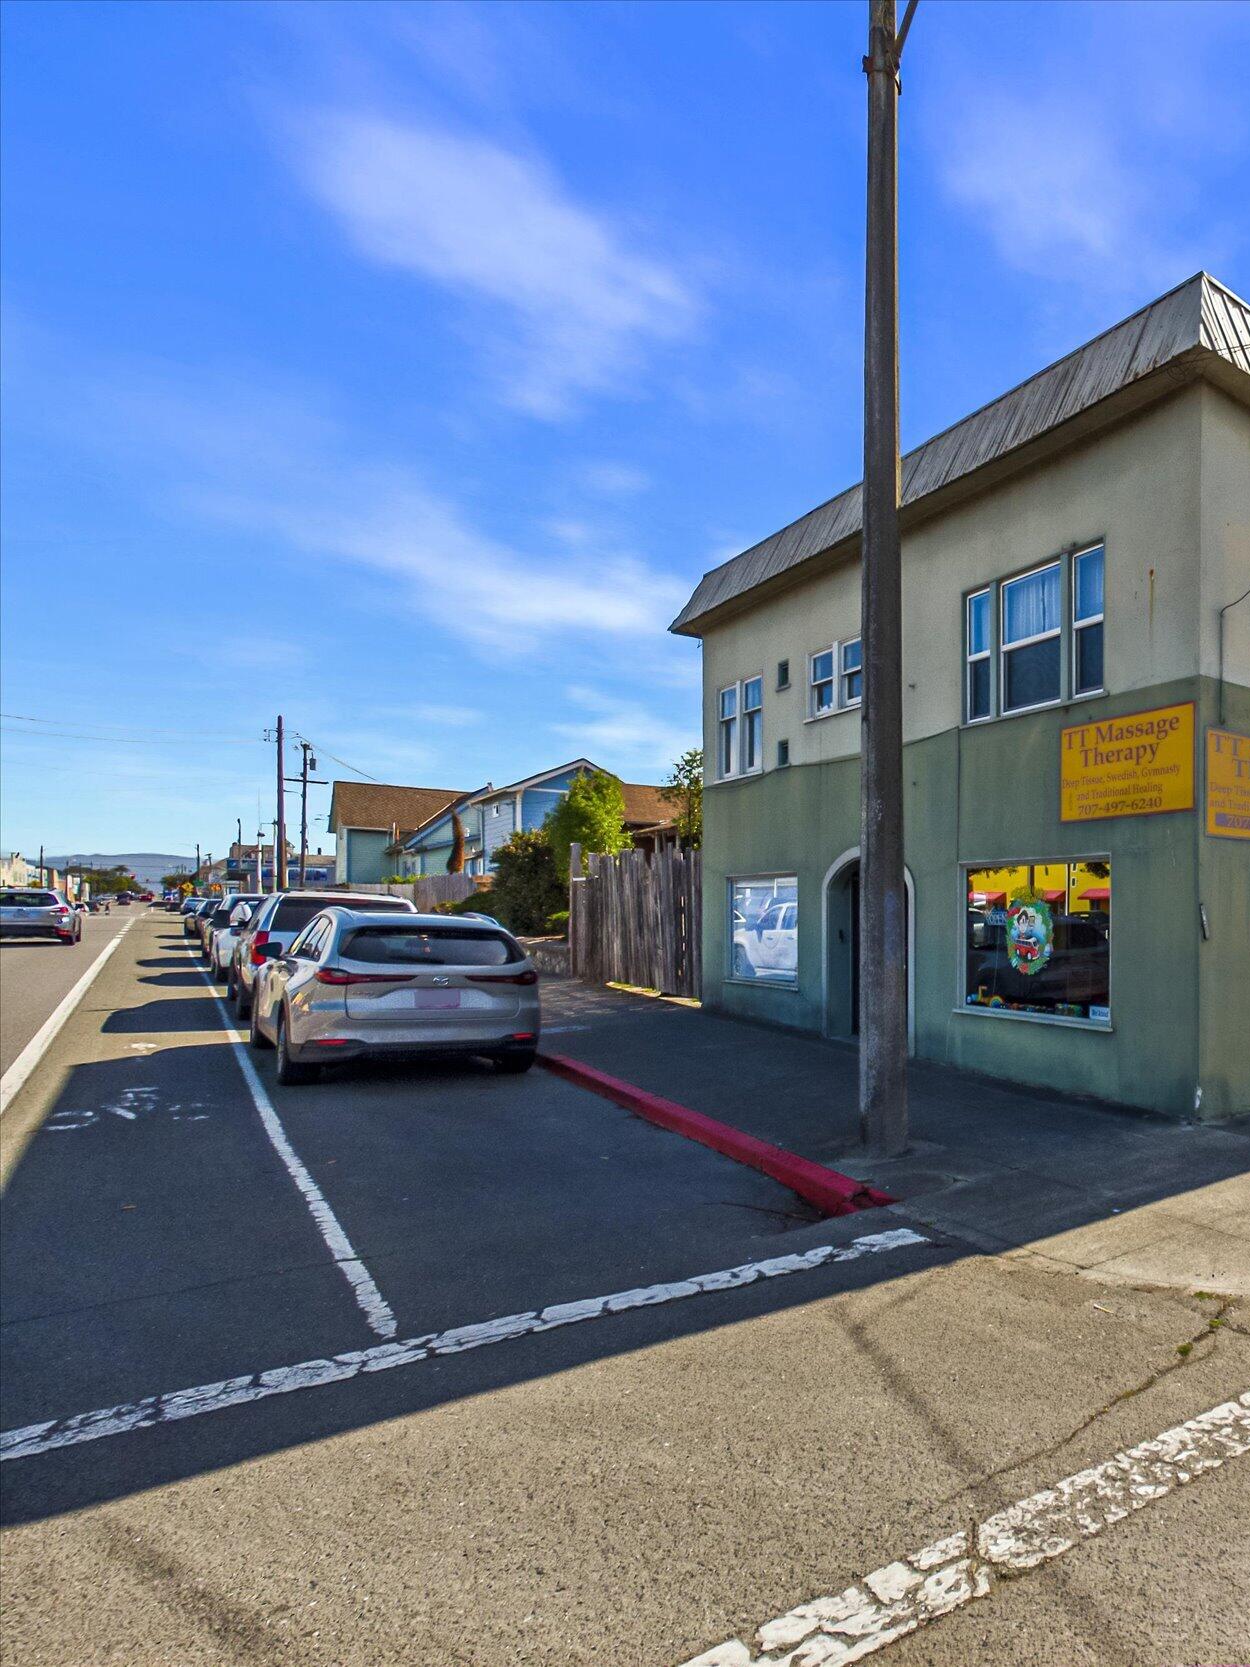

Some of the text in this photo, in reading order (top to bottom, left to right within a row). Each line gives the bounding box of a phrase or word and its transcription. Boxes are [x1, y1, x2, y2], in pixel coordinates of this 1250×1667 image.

[1064, 716, 1181, 750] TT Massage
[1080, 742, 1159, 768] Therapy
[1209, 733, 1242, 757] TT
[1062, 778, 1080, 790] Deep
[1106, 769, 1140, 782] Swedish,
[1076, 783, 1163, 801] and Traditional Healing
[1078, 796, 1163, 816] 707-497-6240
